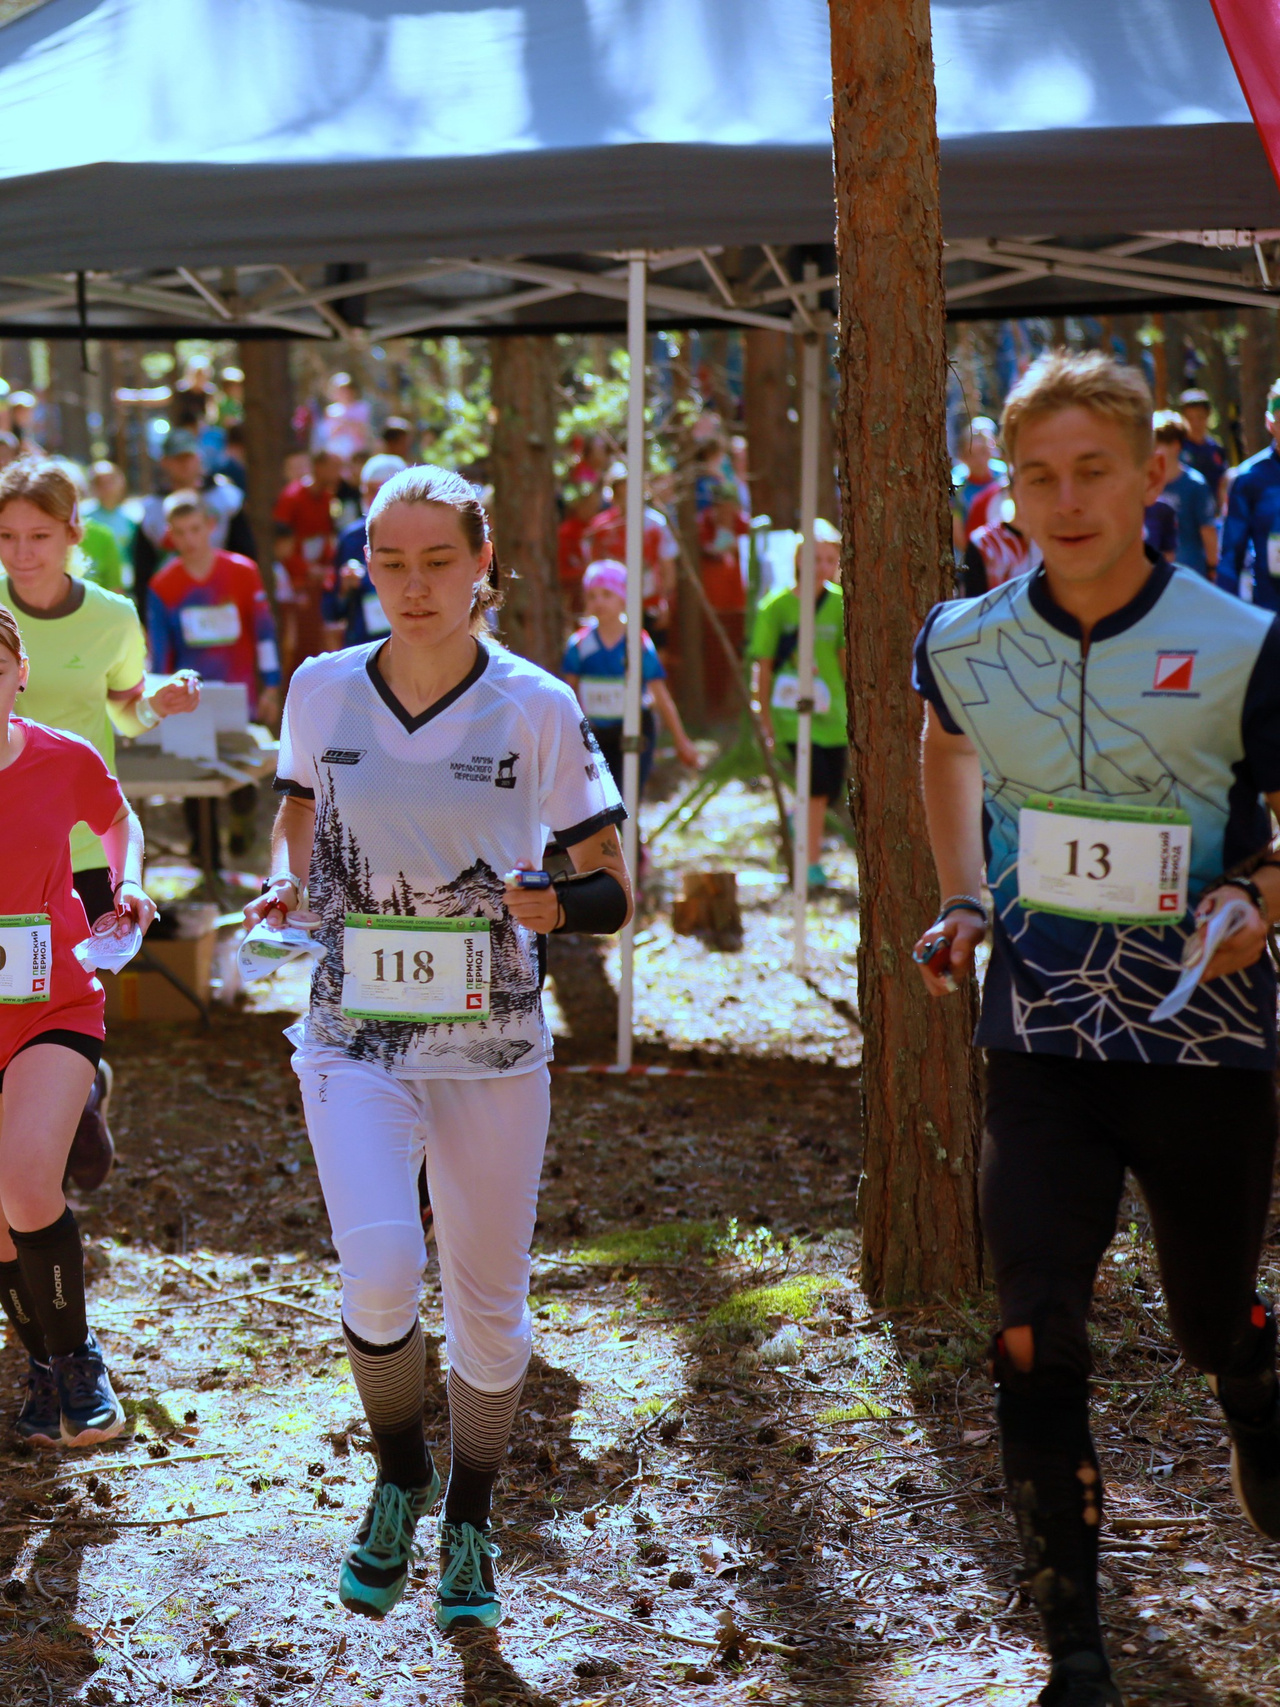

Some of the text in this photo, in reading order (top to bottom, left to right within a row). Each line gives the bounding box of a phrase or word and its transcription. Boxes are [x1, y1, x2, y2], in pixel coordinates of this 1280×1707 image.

[1063, 839, 1112, 880] 13
[31, 930, 39, 976] ПЕРМСКИЙ
[371, 948, 435, 984] 118
[464, 938, 474, 990] ПЕРМСКИЙ
[475, 950, 484, 990] ПЕРИОД
